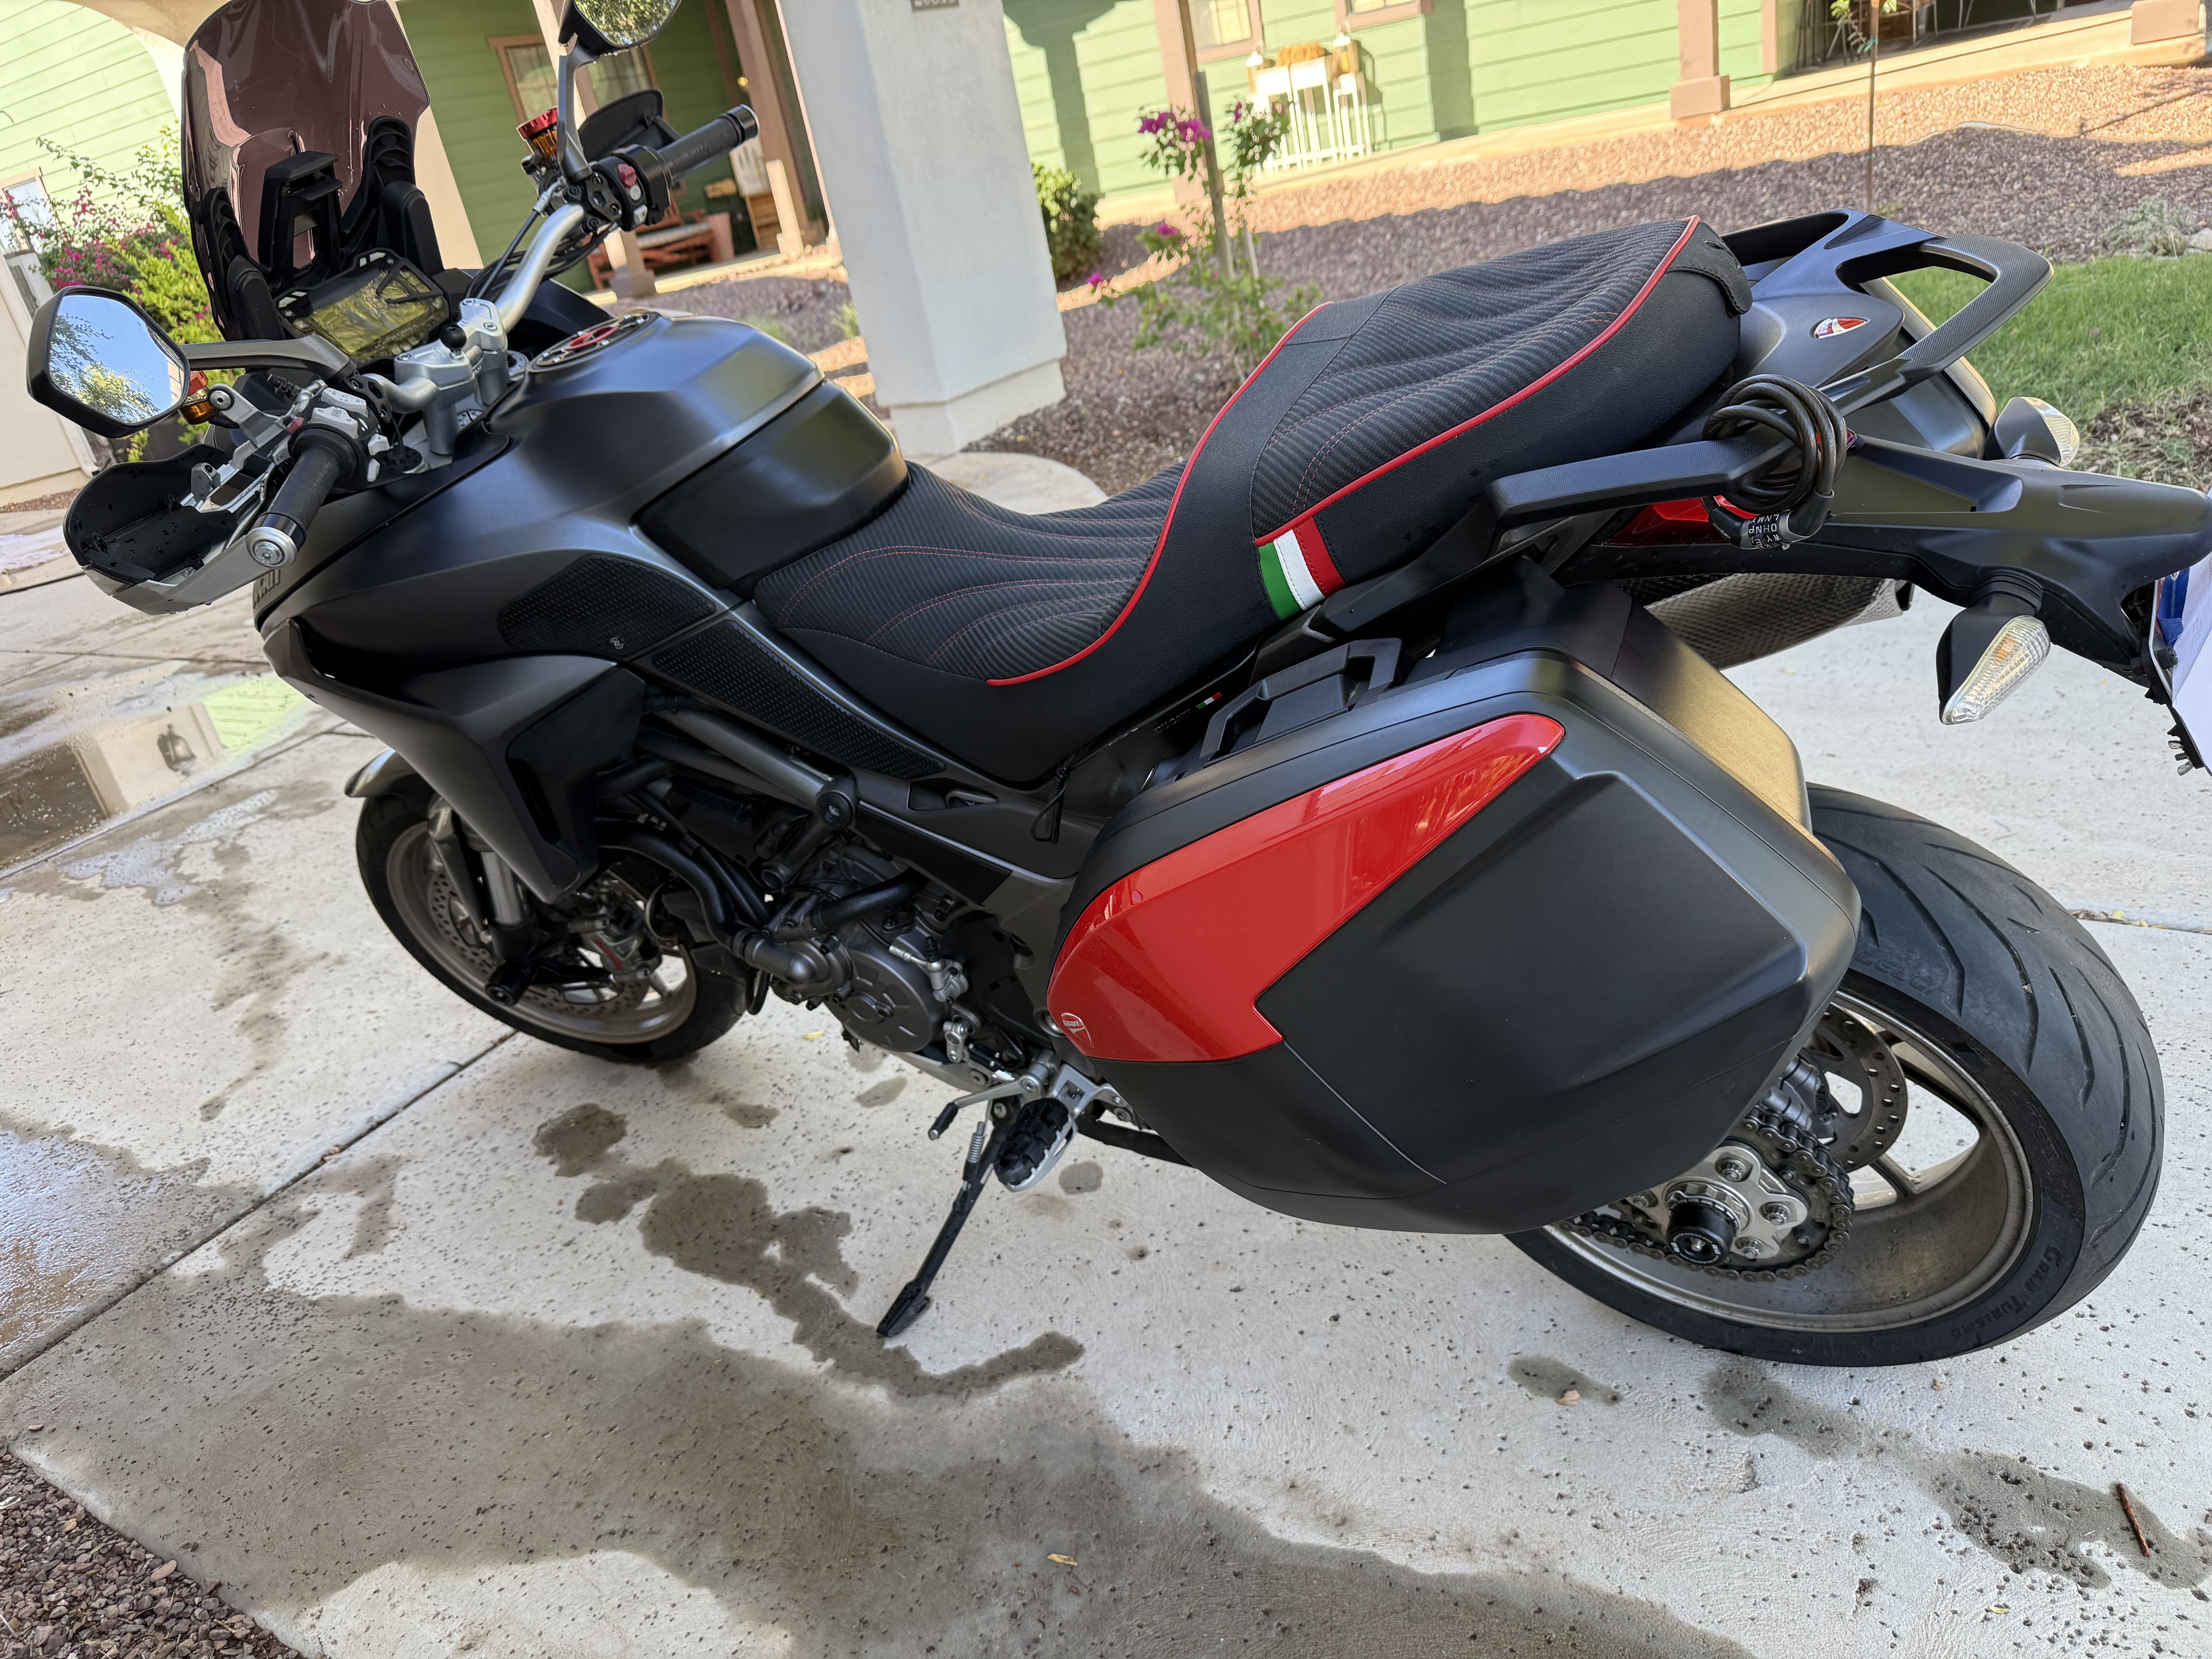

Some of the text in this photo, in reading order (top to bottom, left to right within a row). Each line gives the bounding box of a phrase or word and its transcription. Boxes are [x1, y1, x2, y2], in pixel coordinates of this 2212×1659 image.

[1750, 514, 1779, 523] LNMY
[1951, 1244, 2064, 1338] GRAN TURISMO
